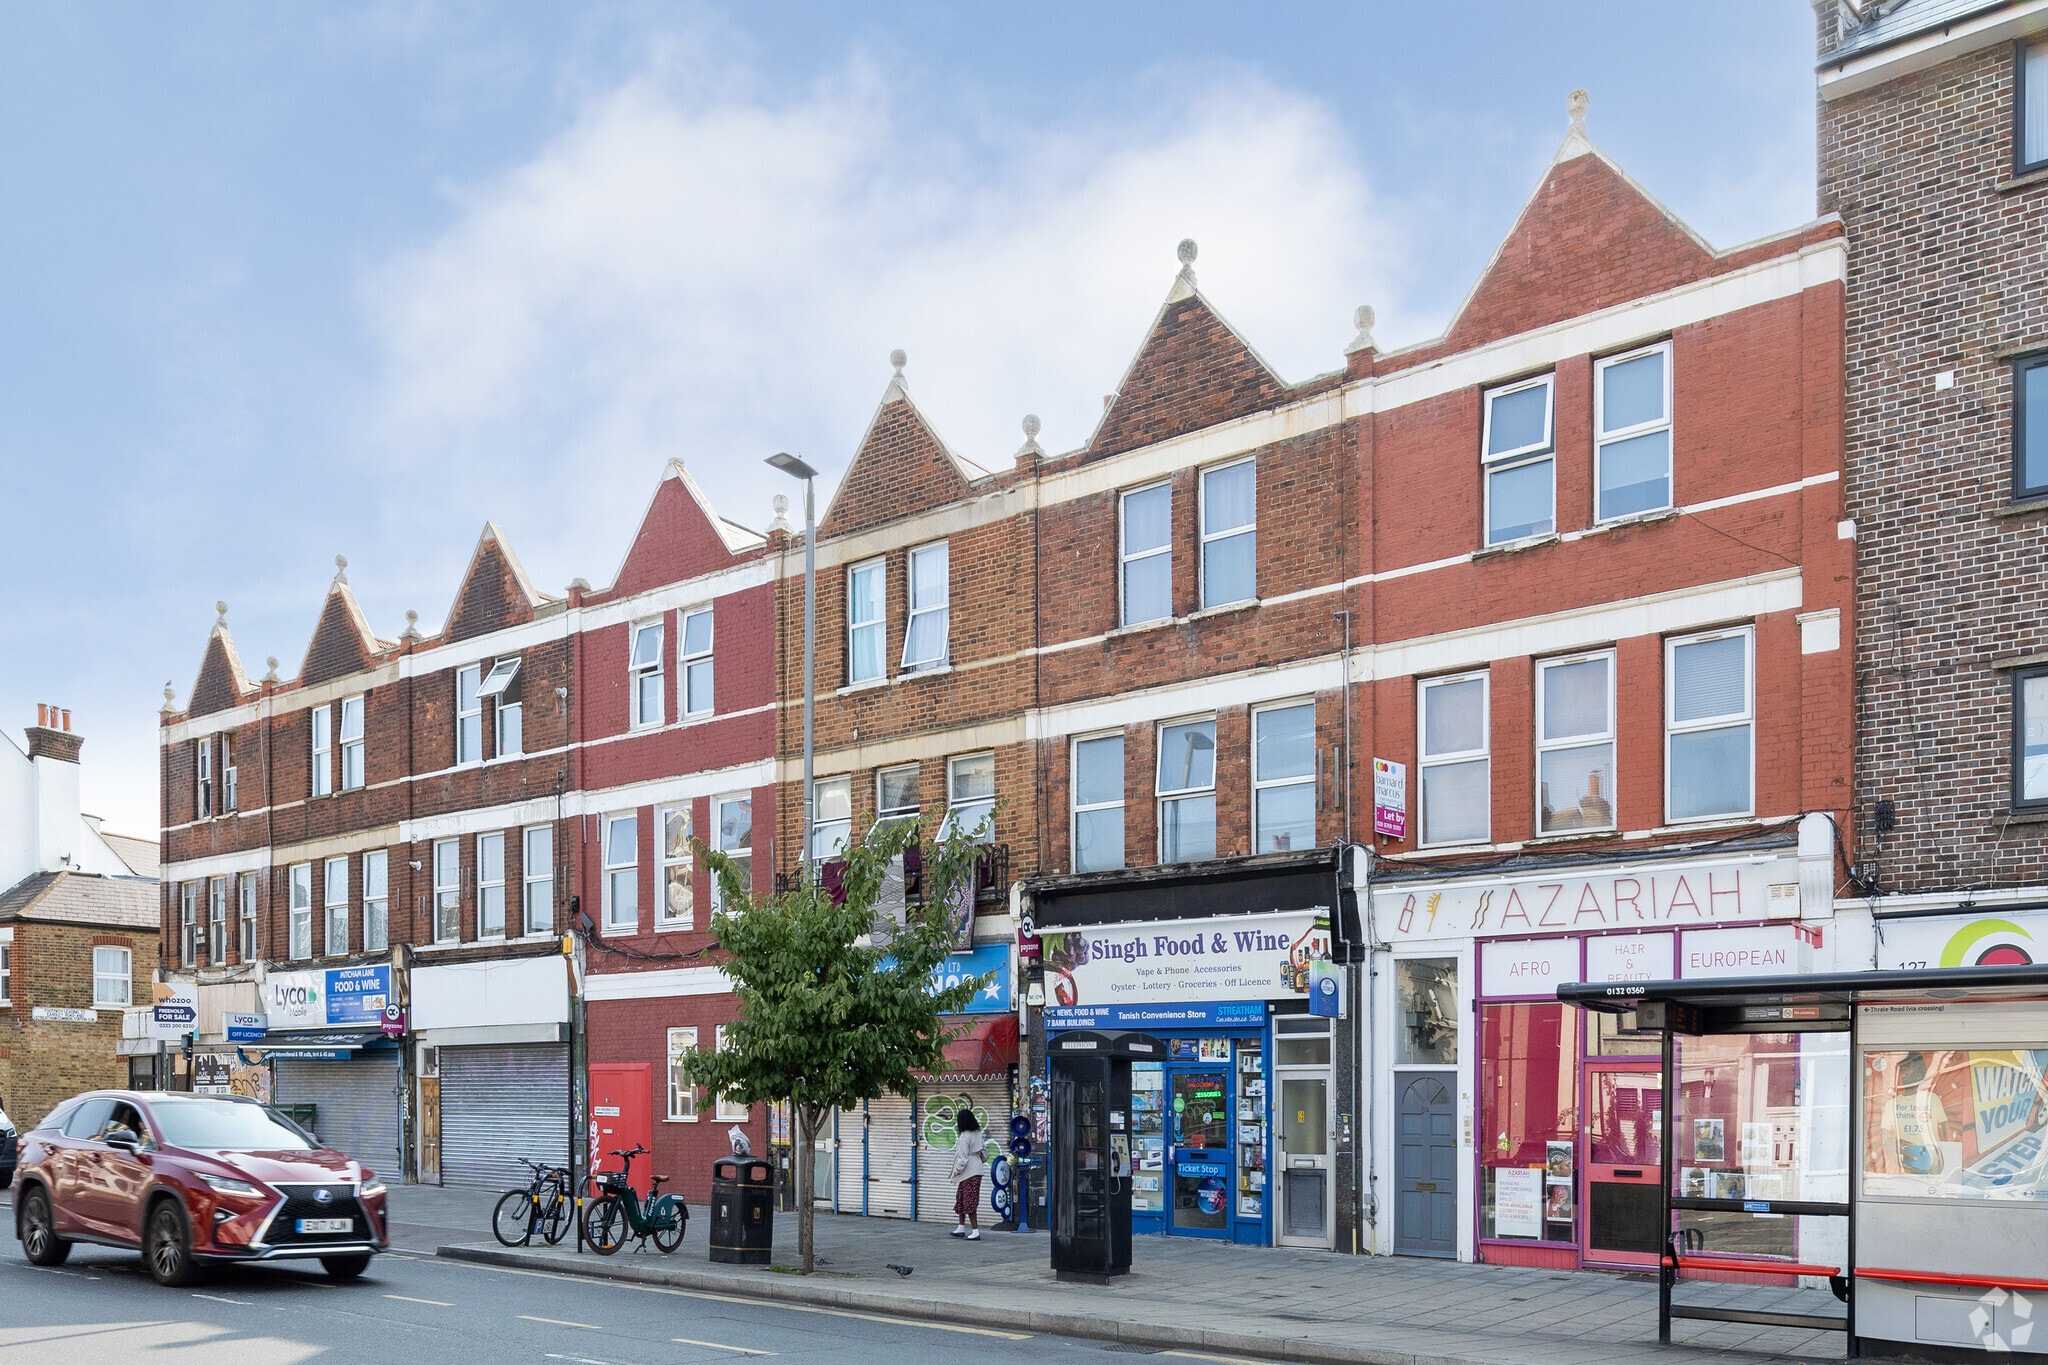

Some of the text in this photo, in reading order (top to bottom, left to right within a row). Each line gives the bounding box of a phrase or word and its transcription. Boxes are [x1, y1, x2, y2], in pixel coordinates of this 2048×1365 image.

[1376, 772, 1403, 789] barnard
[1376, 785, 1400, 798] marcus
[1384, 810, 1404, 825] Let by
[1500, 870, 1741, 928] AZARIAH
[1020, 944, 1039, 952] payzone
[1092, 930, 1290, 963] Singh Food & Wine
[1615, 944, 1645, 955] HAIR
[1626, 958, 1634, 969] &
[1690, 949, 1786, 968] EUROPEAN
[340, 968, 374, 978] MITCHAM LANE
[948, 962, 961, 972] LTD
[1136, 968, 1154, 978] Vape
[1164, 966, 1190, 975] Phone
[1194, 964, 1242, 974] Accessories
[1509, 960, 1551, 976] AFRO
[1608, 972, 1652, 982] BEAUTY
[334, 979, 380, 992] FOOD & WINE
[1110, 983, 1136, 992] Oyster
[1142, 982, 1172, 991] Lottery
[1178, 980, 1218, 988] Groceries
[1224, 978, 1237, 987] Off
[1239, 978, 1272, 986] Licence
[1626, 986, 1645, 994] 0360
[158, 996, 192, 1004] whozoo
[276, 984, 307, 1010] Lyca
[1057, 1009, 1074, 1017] NEWS,
[1074, 1008, 1088, 1016] FOOD
[1095, 1008, 1110, 1016] WINE
[1118, 1012, 1140, 1020] Tanish
[1141, 1011, 1186, 1019] Convenience
[1218, 1006, 1262, 1016] STREATHAM
[234, 1015, 253, 1024] Lyca
[1974, 1066, 2036, 1102] WATCH
[1980, 1098, 2032, 1134] YOUR
[1978, 1136, 2042, 1186] STEP
[1178, 1163, 1219, 1176] Ticket Stop
